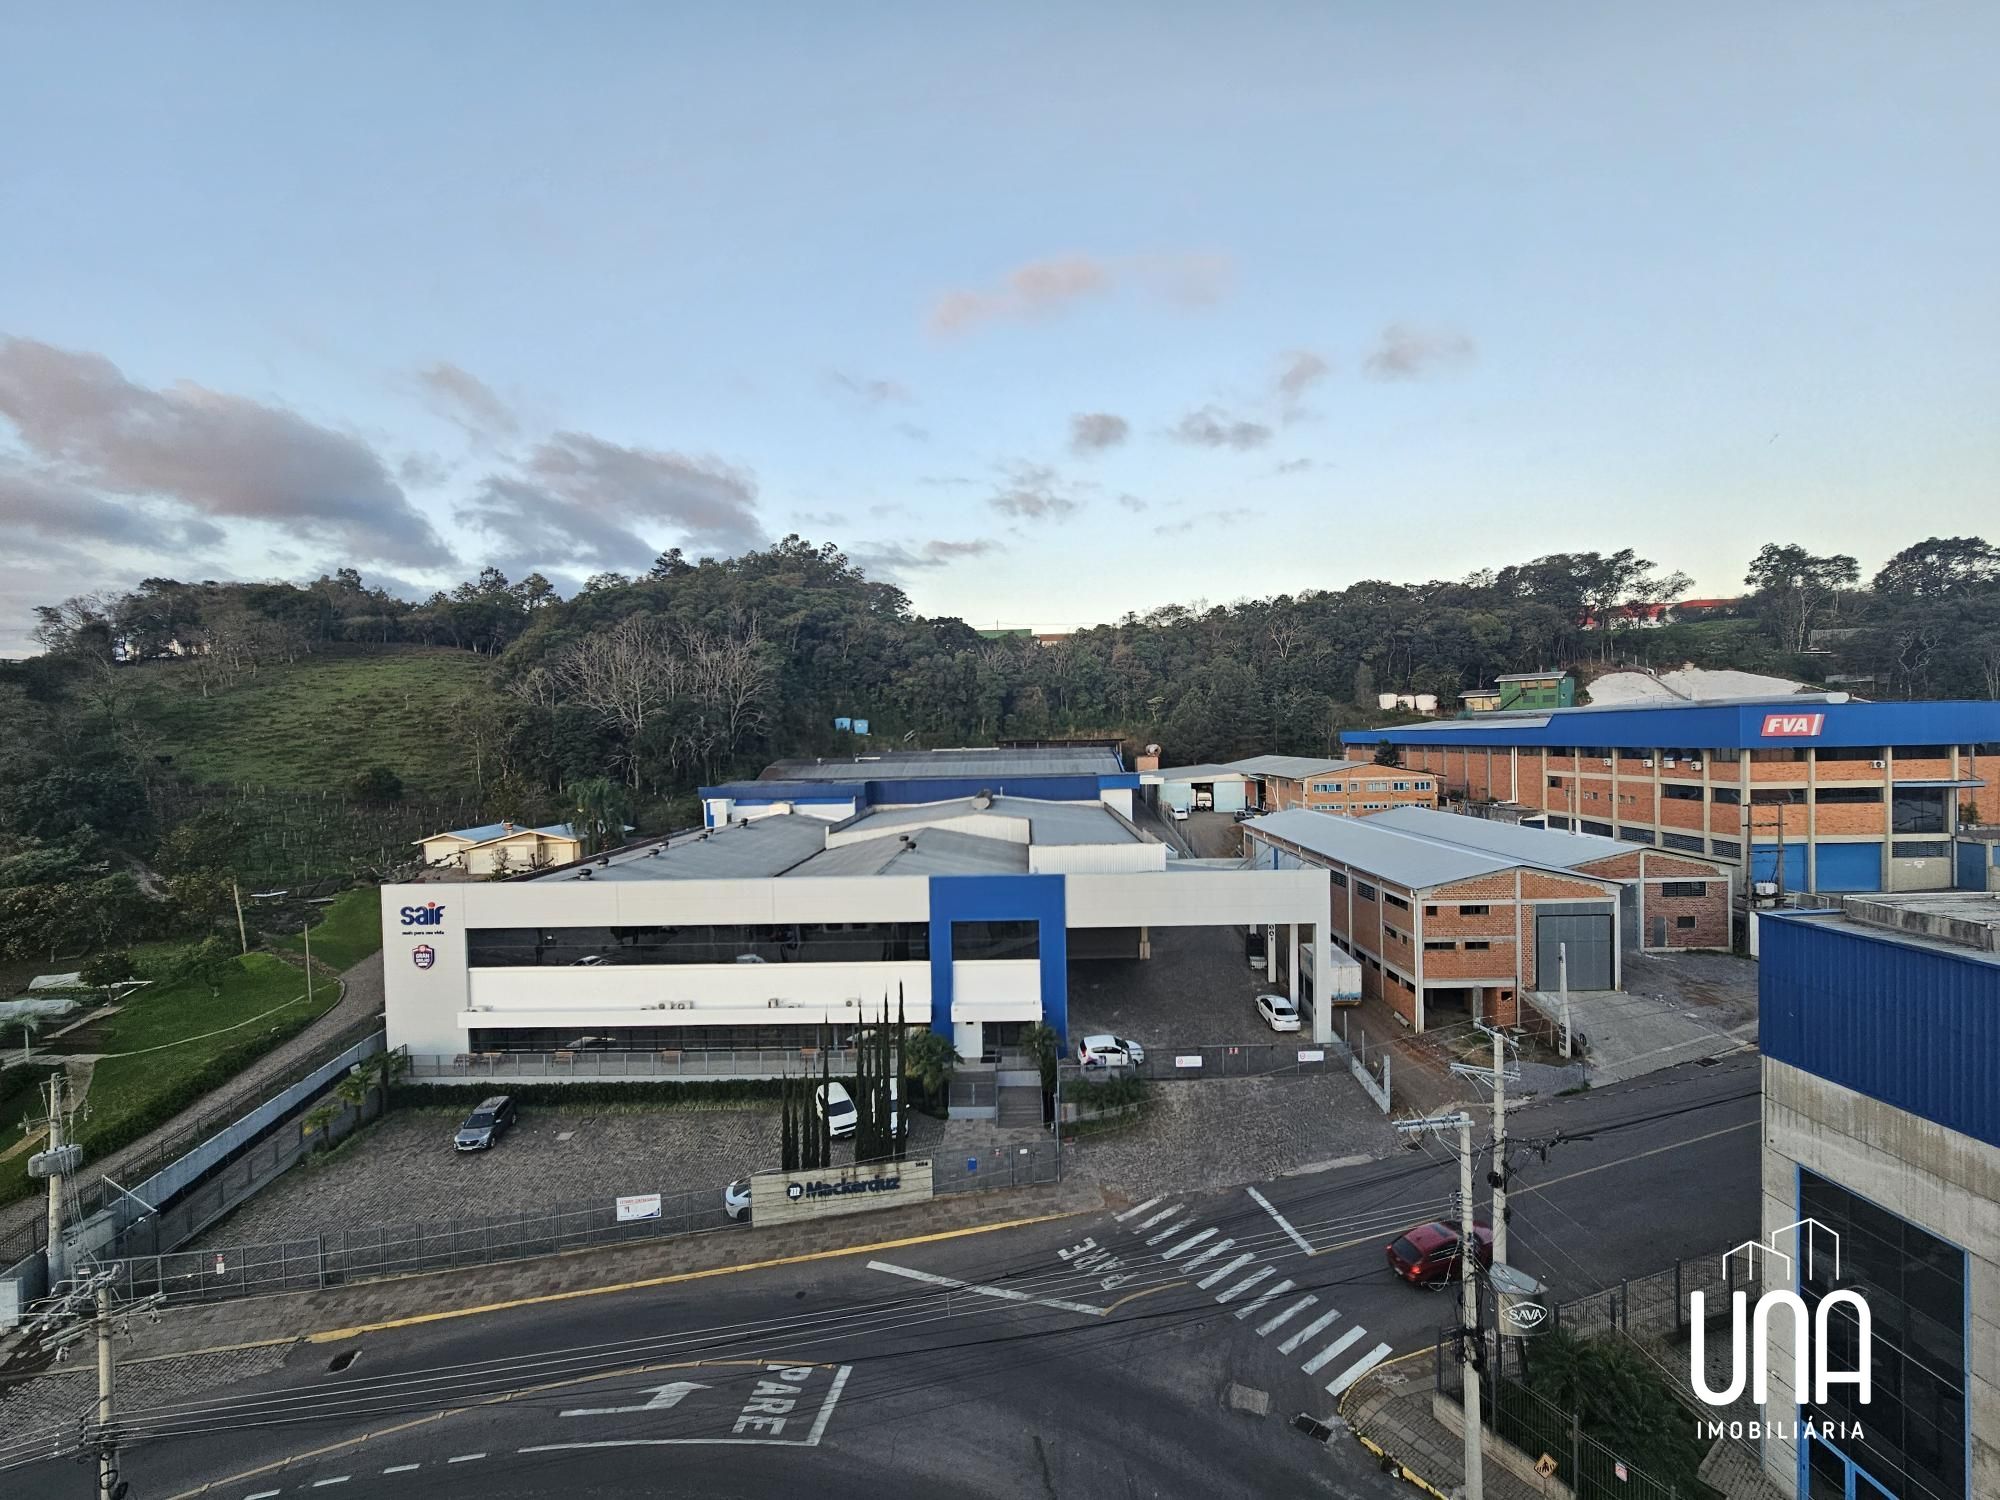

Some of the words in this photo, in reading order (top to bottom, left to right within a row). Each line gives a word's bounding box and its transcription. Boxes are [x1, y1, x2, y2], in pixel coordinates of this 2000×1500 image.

[1767, 718, 1808, 733] FVA
[400, 901, 446, 926] saif
[1509, 1308, 1542, 1321] SAVA
[731, 1364, 814, 1436] PARE
